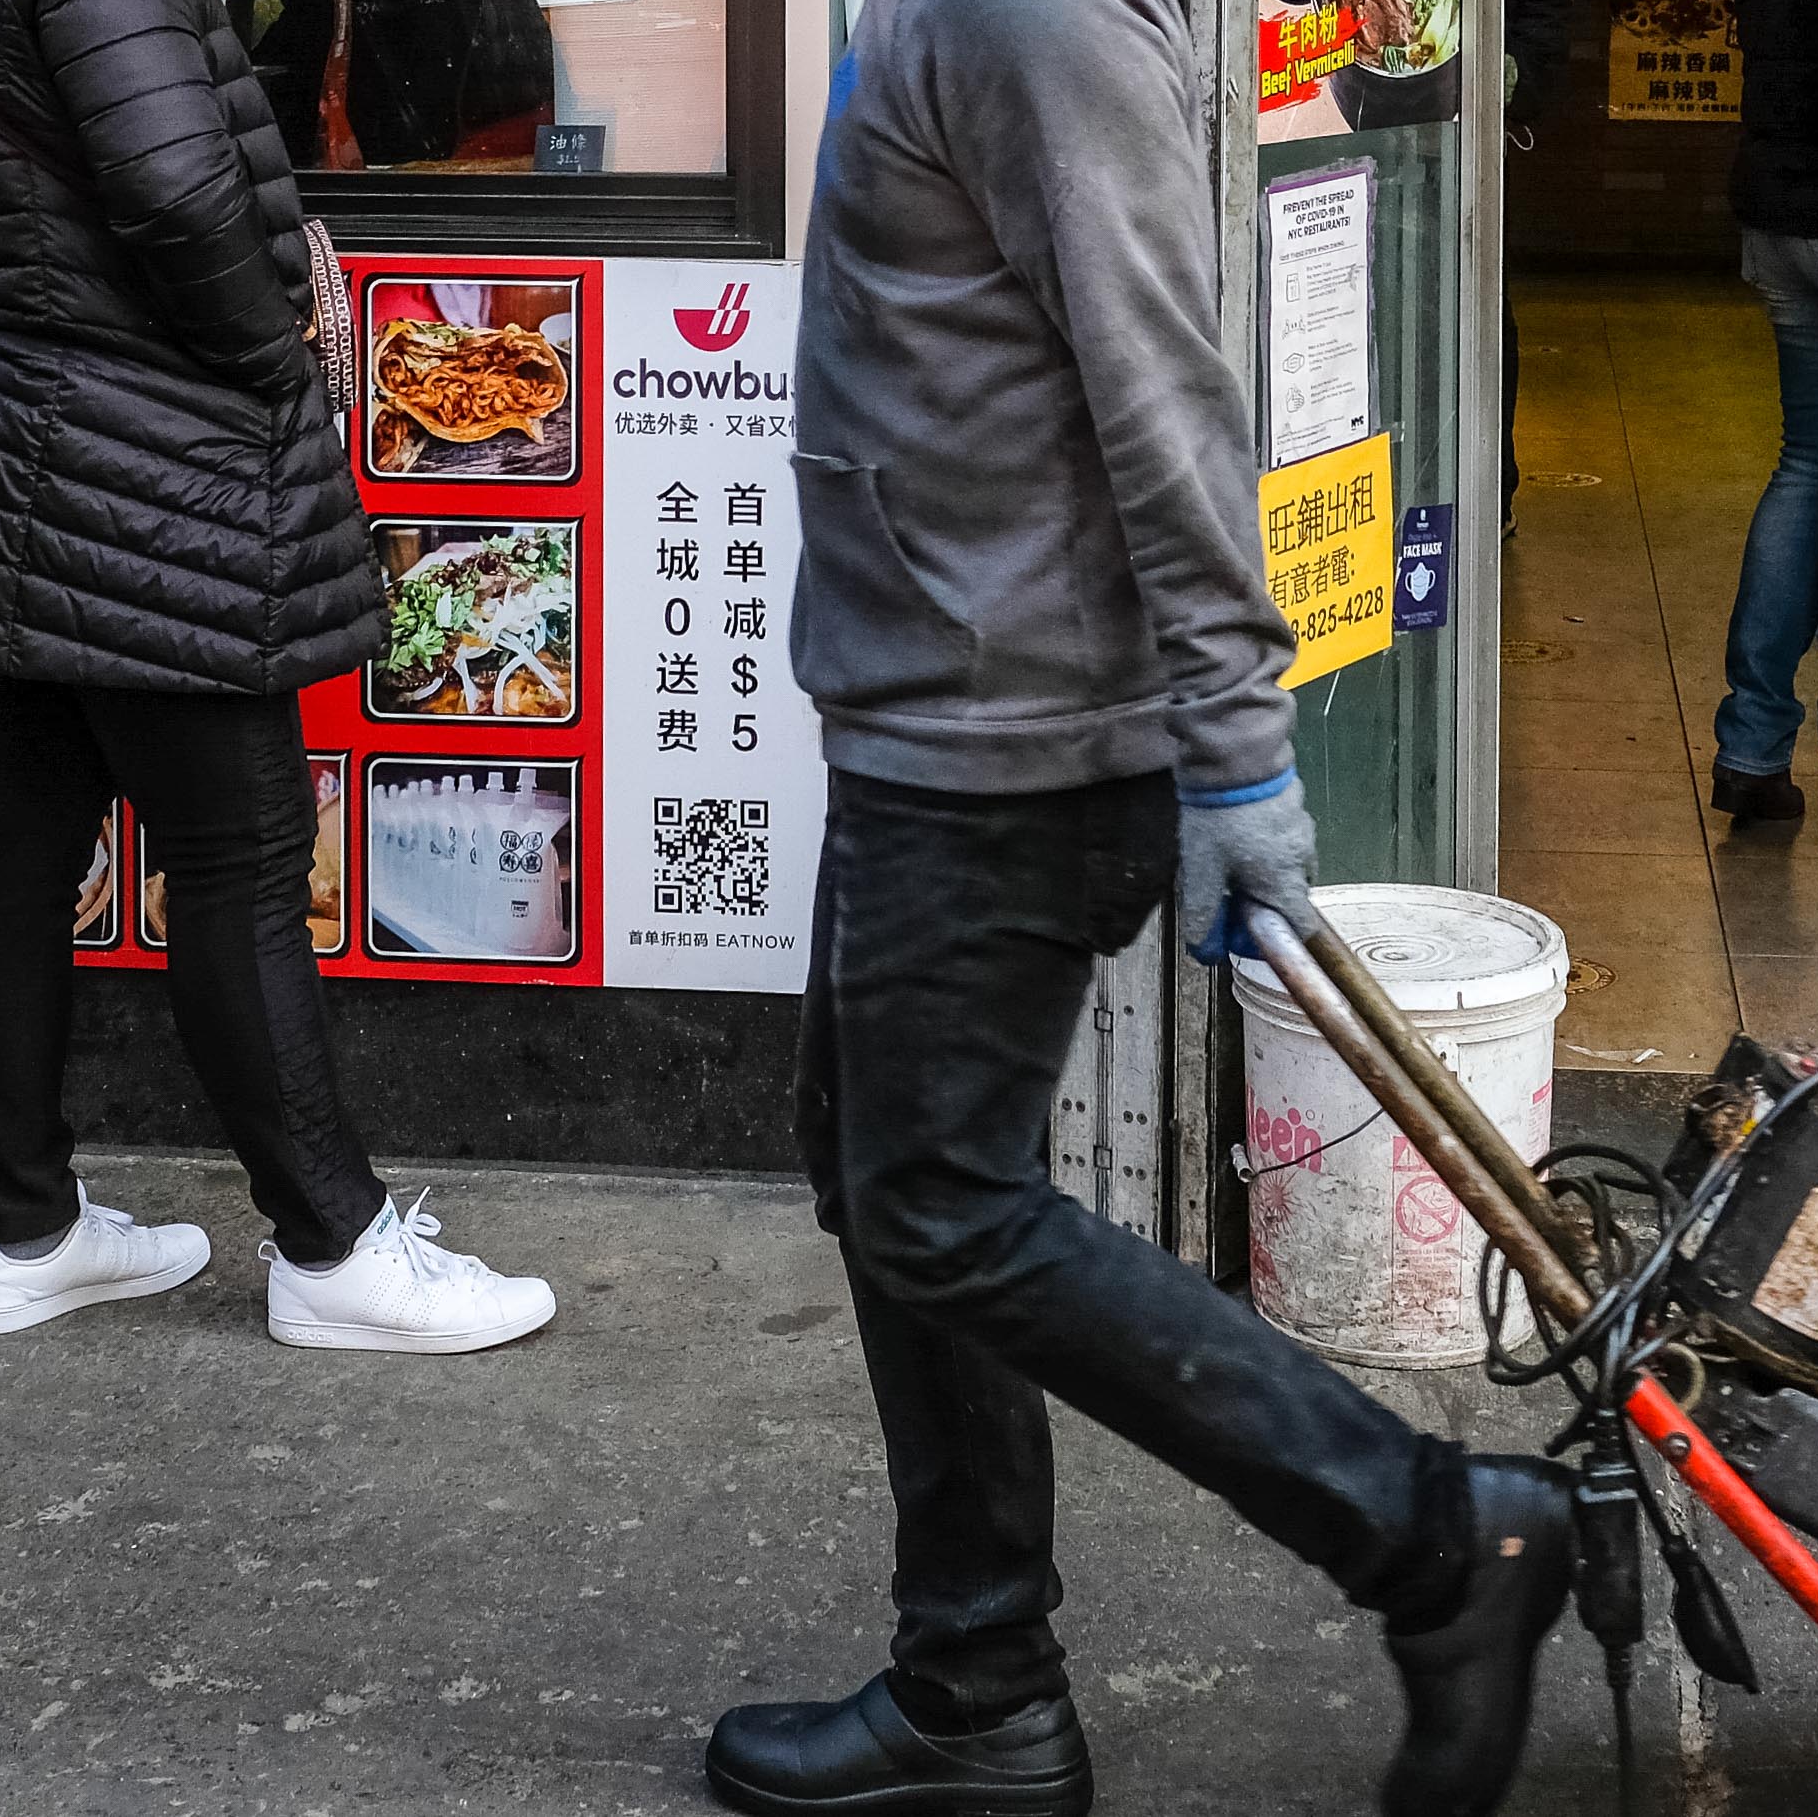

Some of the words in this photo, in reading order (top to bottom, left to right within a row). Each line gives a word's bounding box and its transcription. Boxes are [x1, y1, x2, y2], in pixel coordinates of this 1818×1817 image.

[1278, 1, 1338, 58] 牛肉粉
[1261, 63, 1291, 98] Beef
[1295, 38, 1354, 84] Vermicelli
[1283, 196, 1314, 214] PREVENT
[1315, 195, 1326, 207] THE
[1328, 189, 1354, 204] SPREAD
[1288, 228, 1302, 240] NYC
[613, 358, 795, 401] chowbu
[726, 414, 796, 437] 又省又
[1268, 471, 1375, 556] 旺鋪出租
[656, 481, 699, 753] 全城0送费
[723, 482, 767, 753] 首单减$5
[629, 930, 708, 947] 首单折扣码
[716, 934, 795, 949] EATNOW
